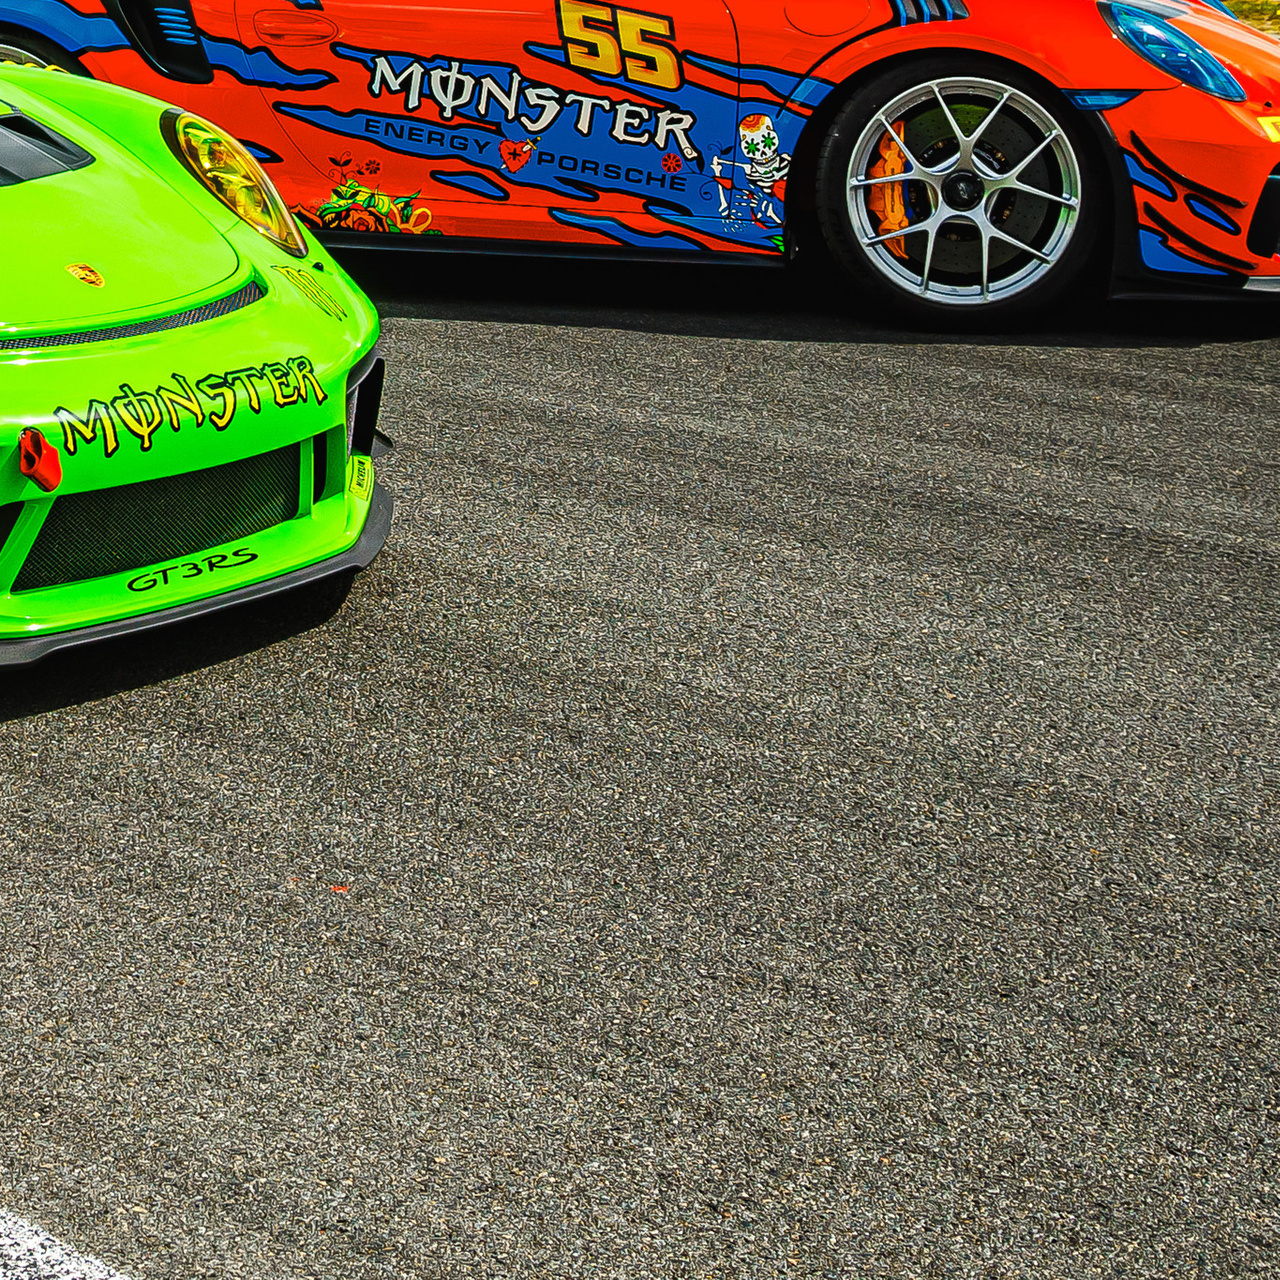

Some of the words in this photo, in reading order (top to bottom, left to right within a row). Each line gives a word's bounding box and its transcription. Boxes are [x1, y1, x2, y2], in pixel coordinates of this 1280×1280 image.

[363, 119, 492, 154] ENERGY
[536, 151, 688, 193] PORSCHE
[127, 548, 259, 593] GT3RS
